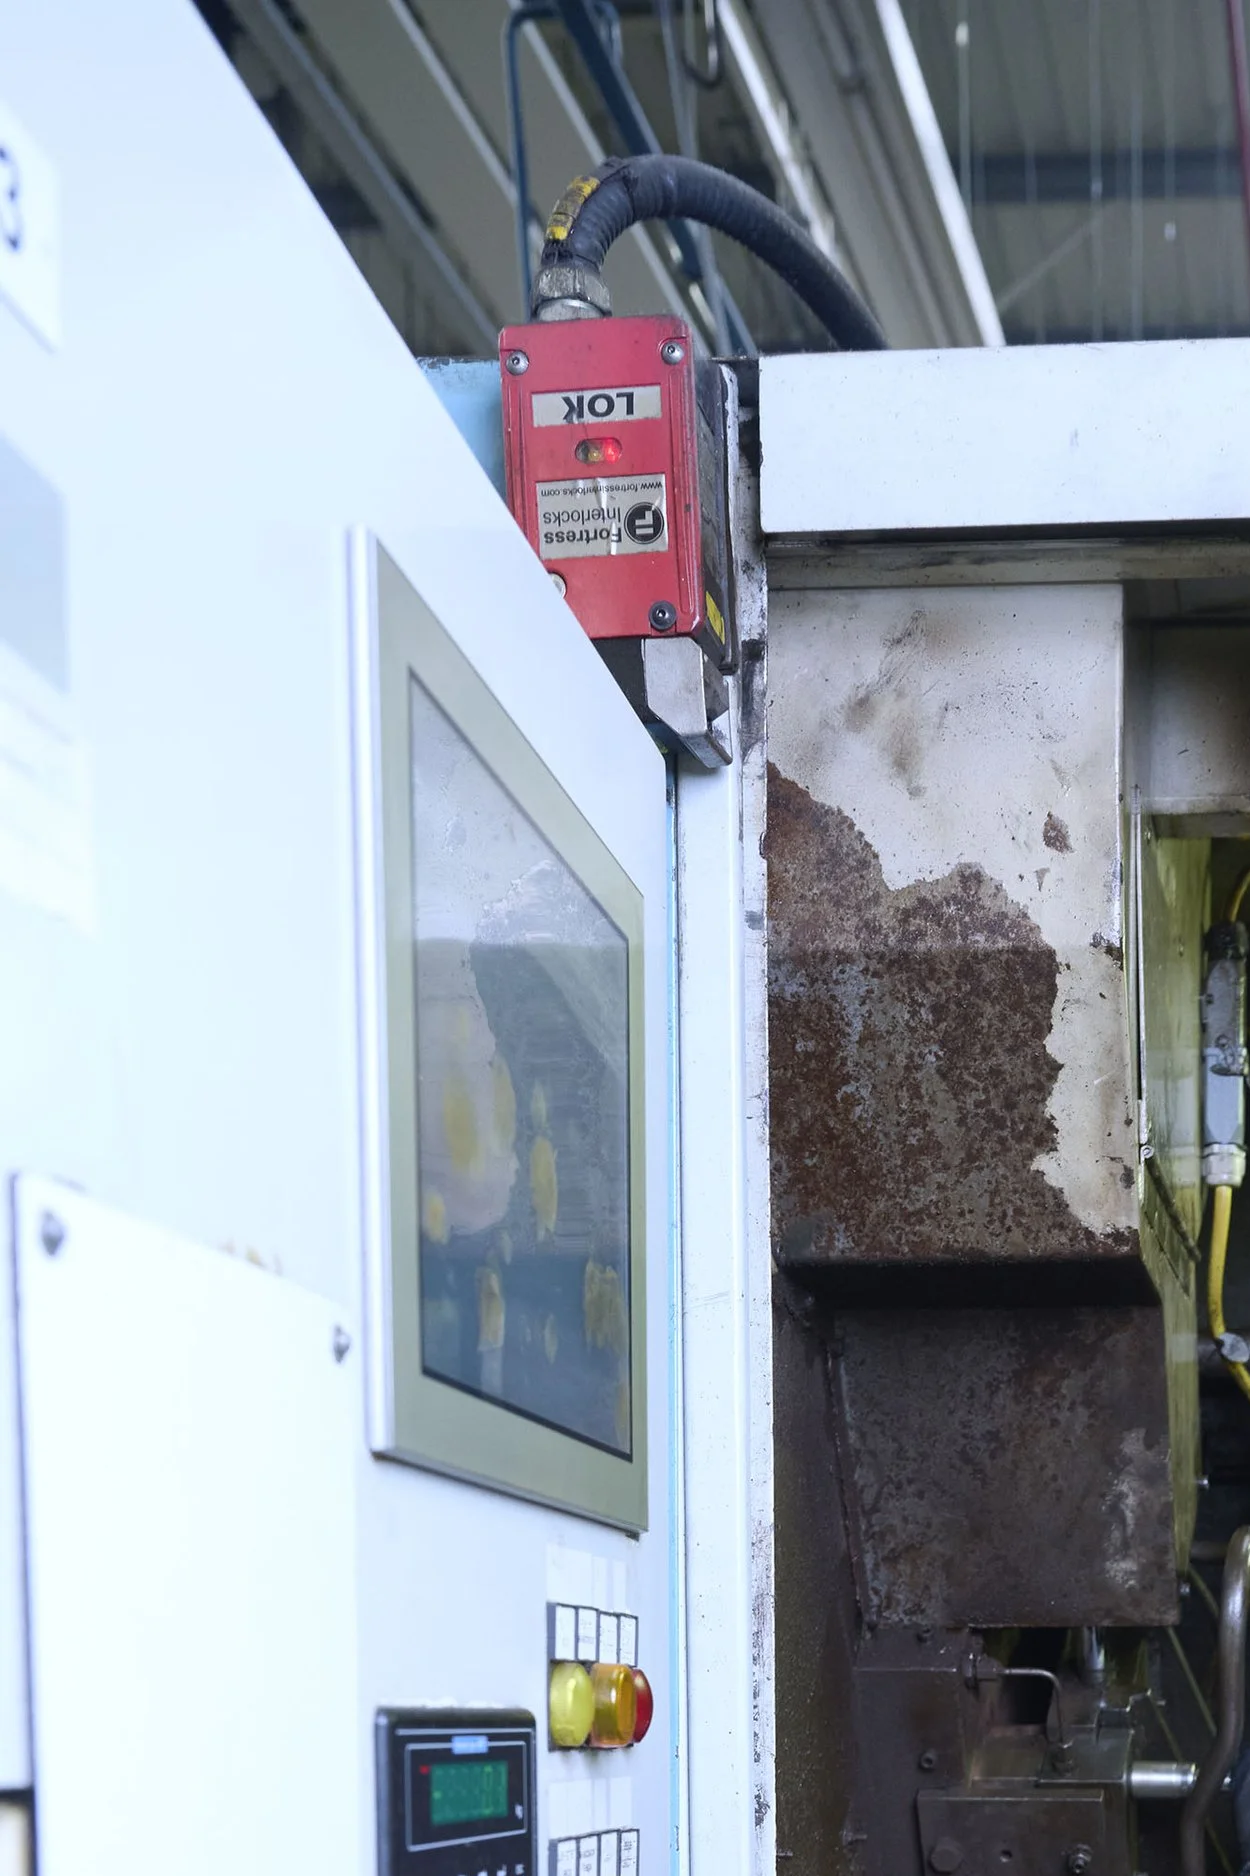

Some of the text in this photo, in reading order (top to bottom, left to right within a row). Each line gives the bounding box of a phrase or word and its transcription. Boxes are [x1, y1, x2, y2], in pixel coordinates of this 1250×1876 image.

[561, 391, 634, 422] LOK
[543, 507, 621, 526] Interlocks
[543, 528, 622, 544] Fortress
